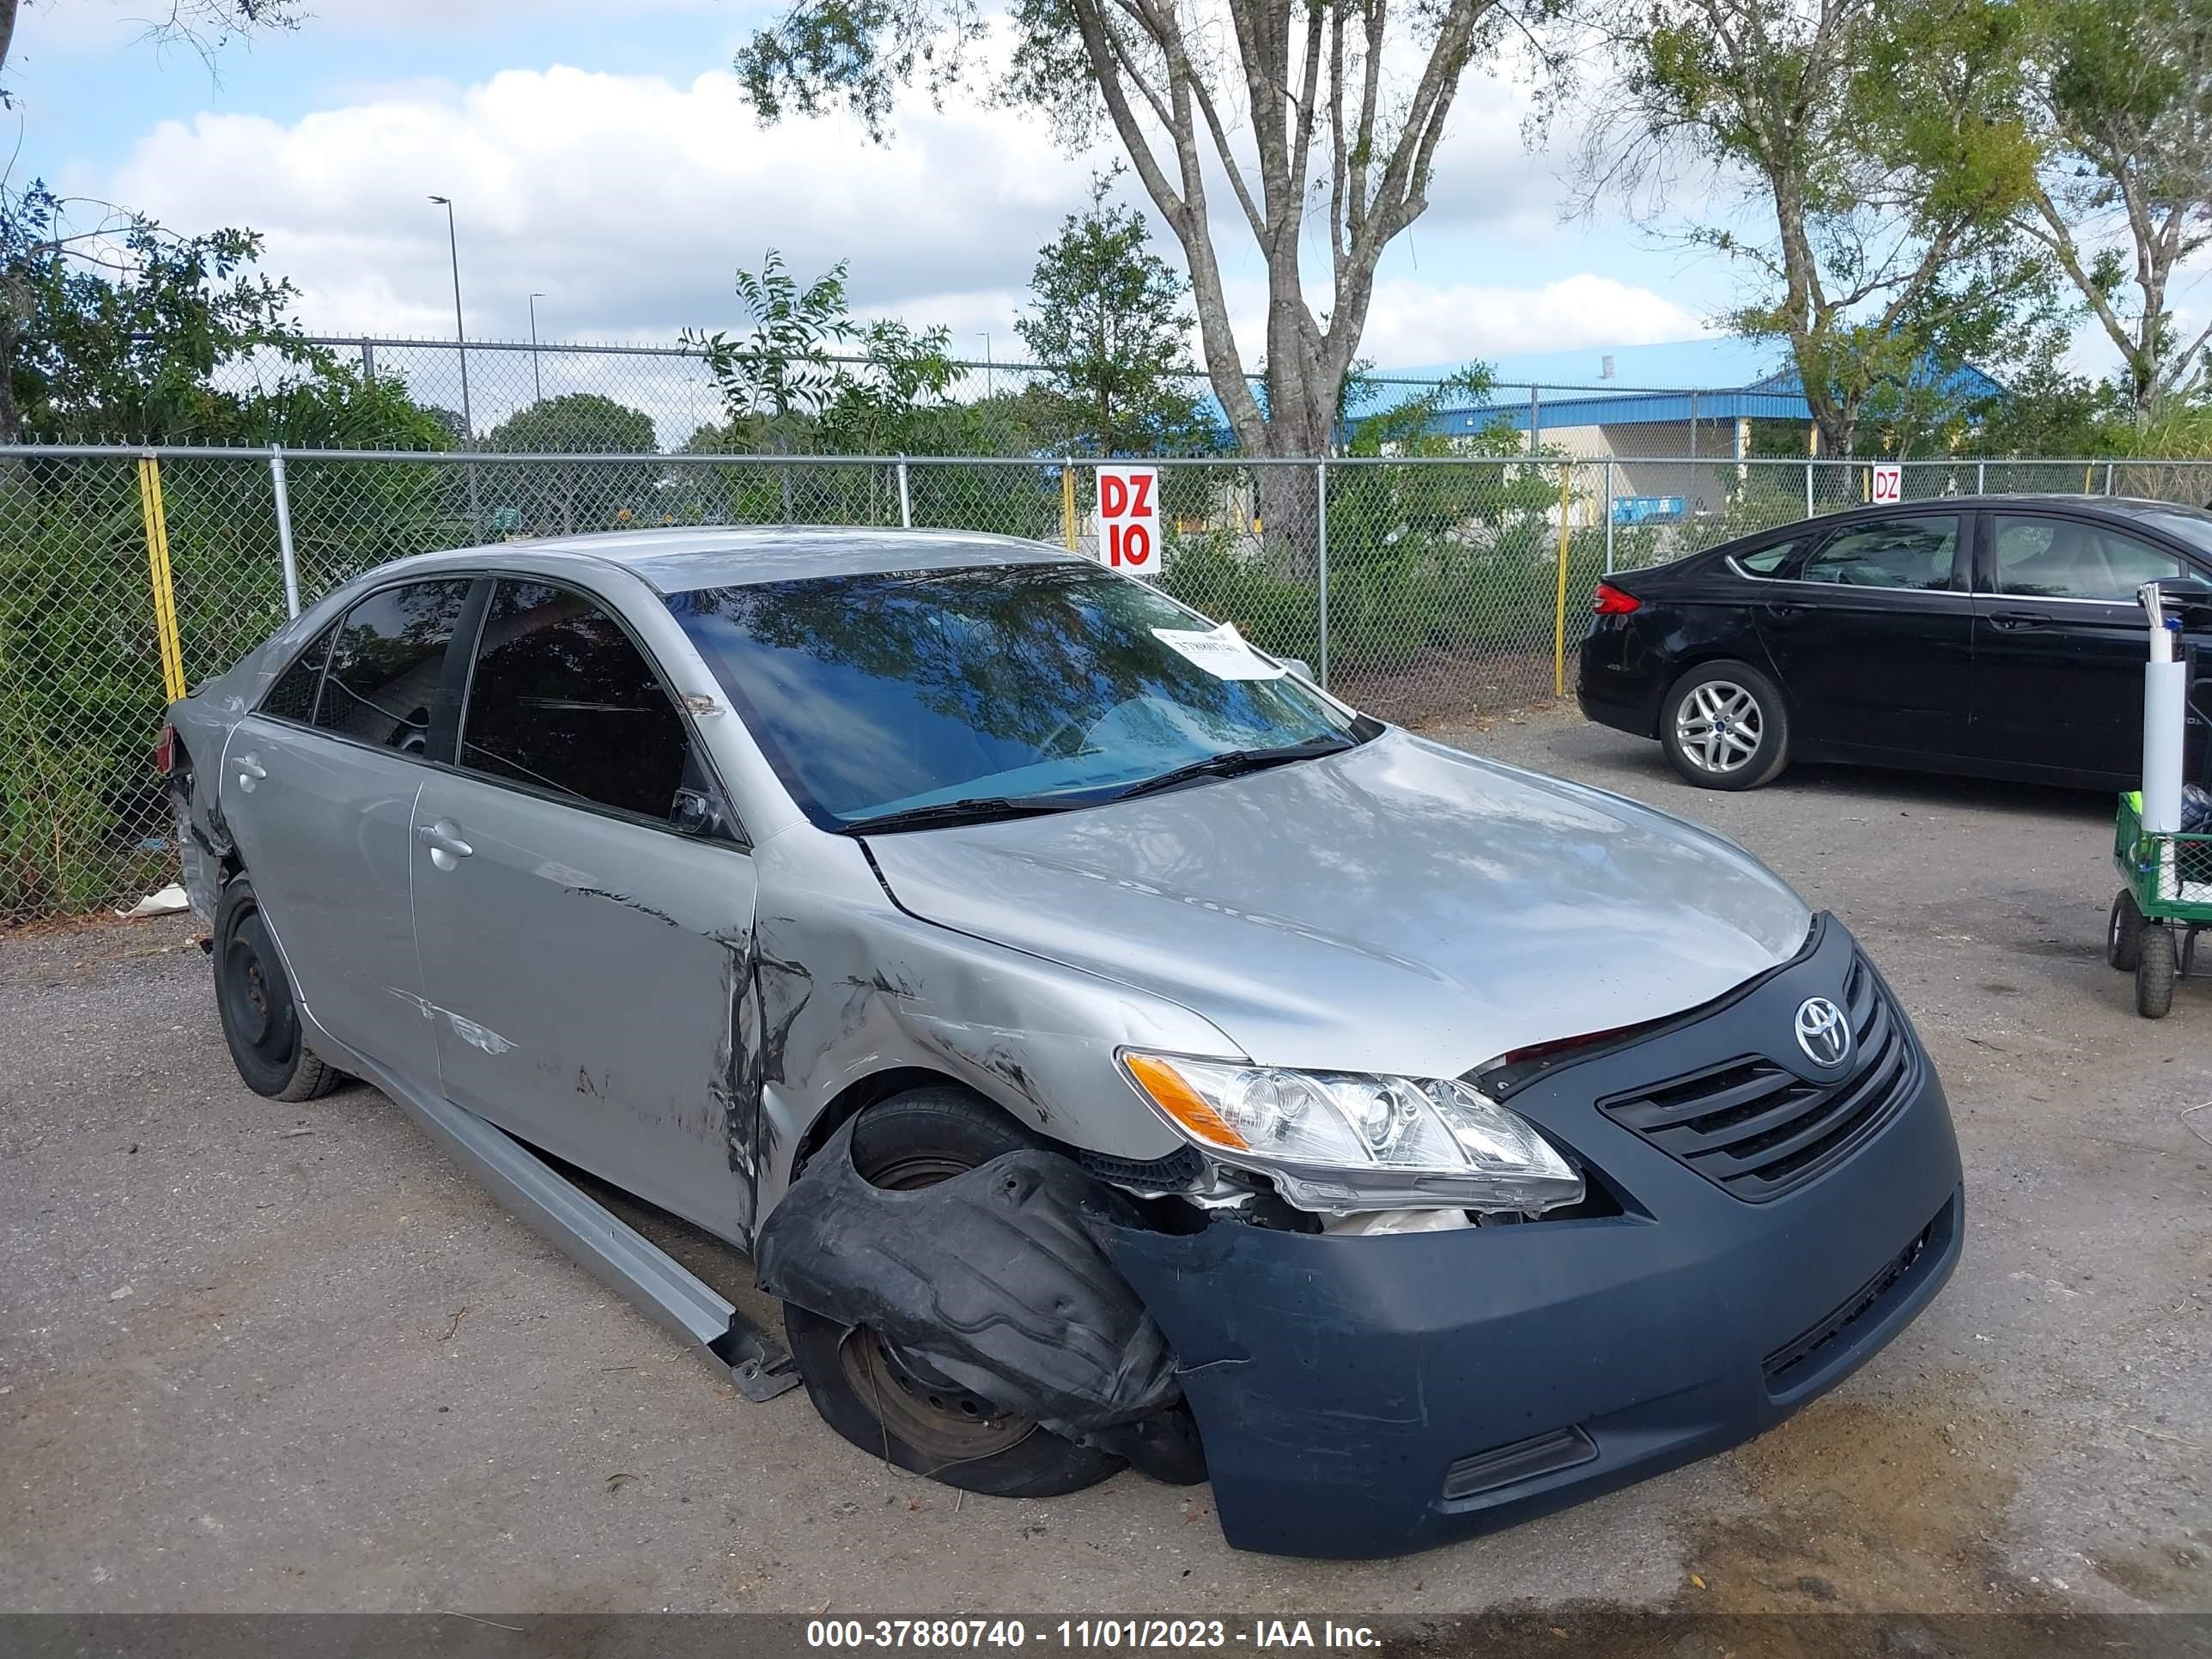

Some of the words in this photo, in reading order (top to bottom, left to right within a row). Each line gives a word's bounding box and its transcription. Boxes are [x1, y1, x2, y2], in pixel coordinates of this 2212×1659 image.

[1101, 476, 1153, 518] DZ
[1877, 472, 1898, 498] DZ
[1109, 524, 1150, 567] 10
